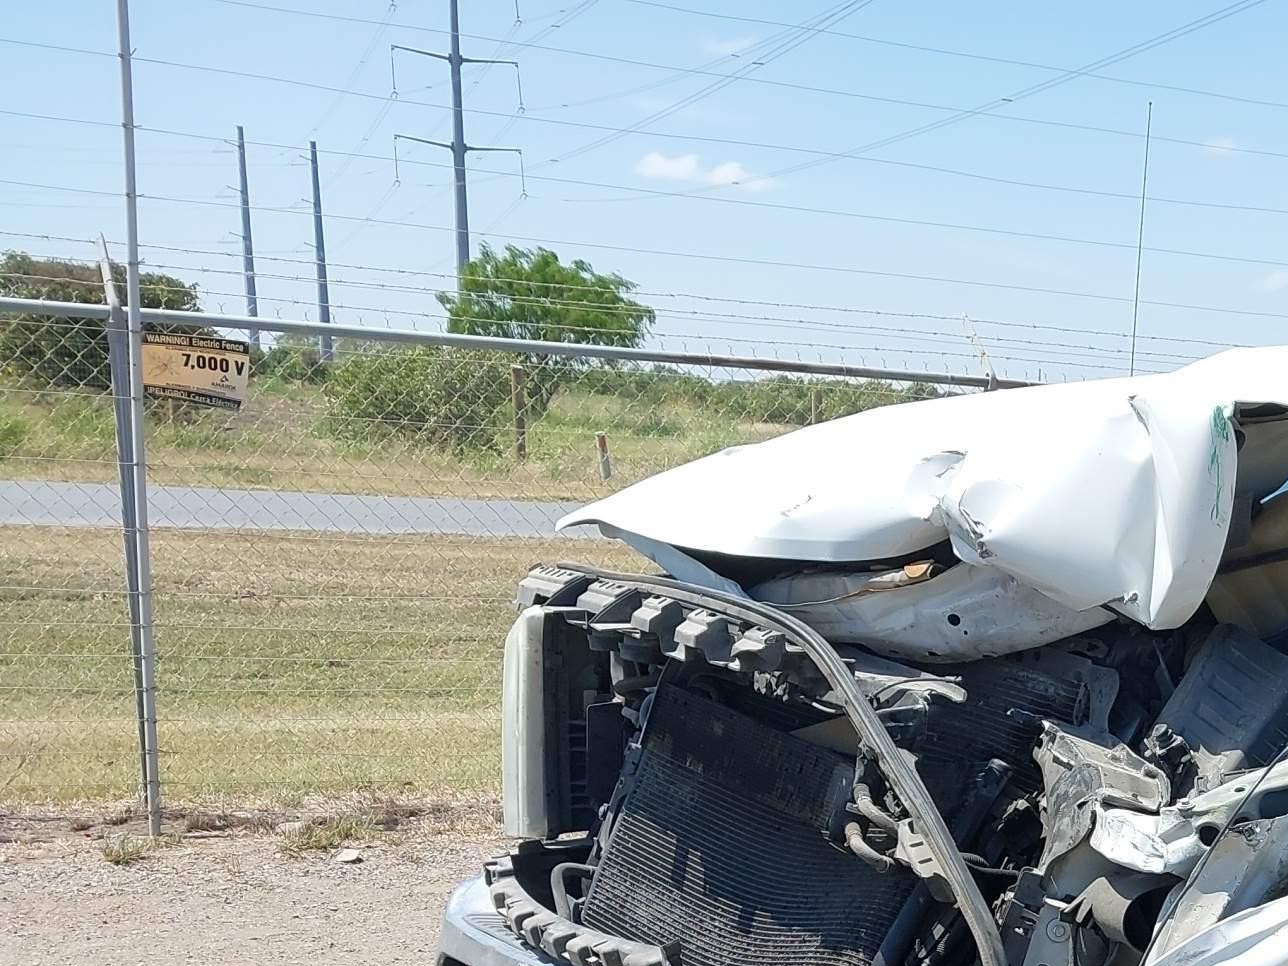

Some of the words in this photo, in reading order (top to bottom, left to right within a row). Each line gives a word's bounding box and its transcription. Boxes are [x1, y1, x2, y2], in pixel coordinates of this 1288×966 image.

[146, 334, 190, 346] WARNING!
[192, 338, 220, 349] Electric
[222, 342, 244, 352] Fence
[181, 353, 229, 373] 7,000
[235, 361, 245, 376] V
